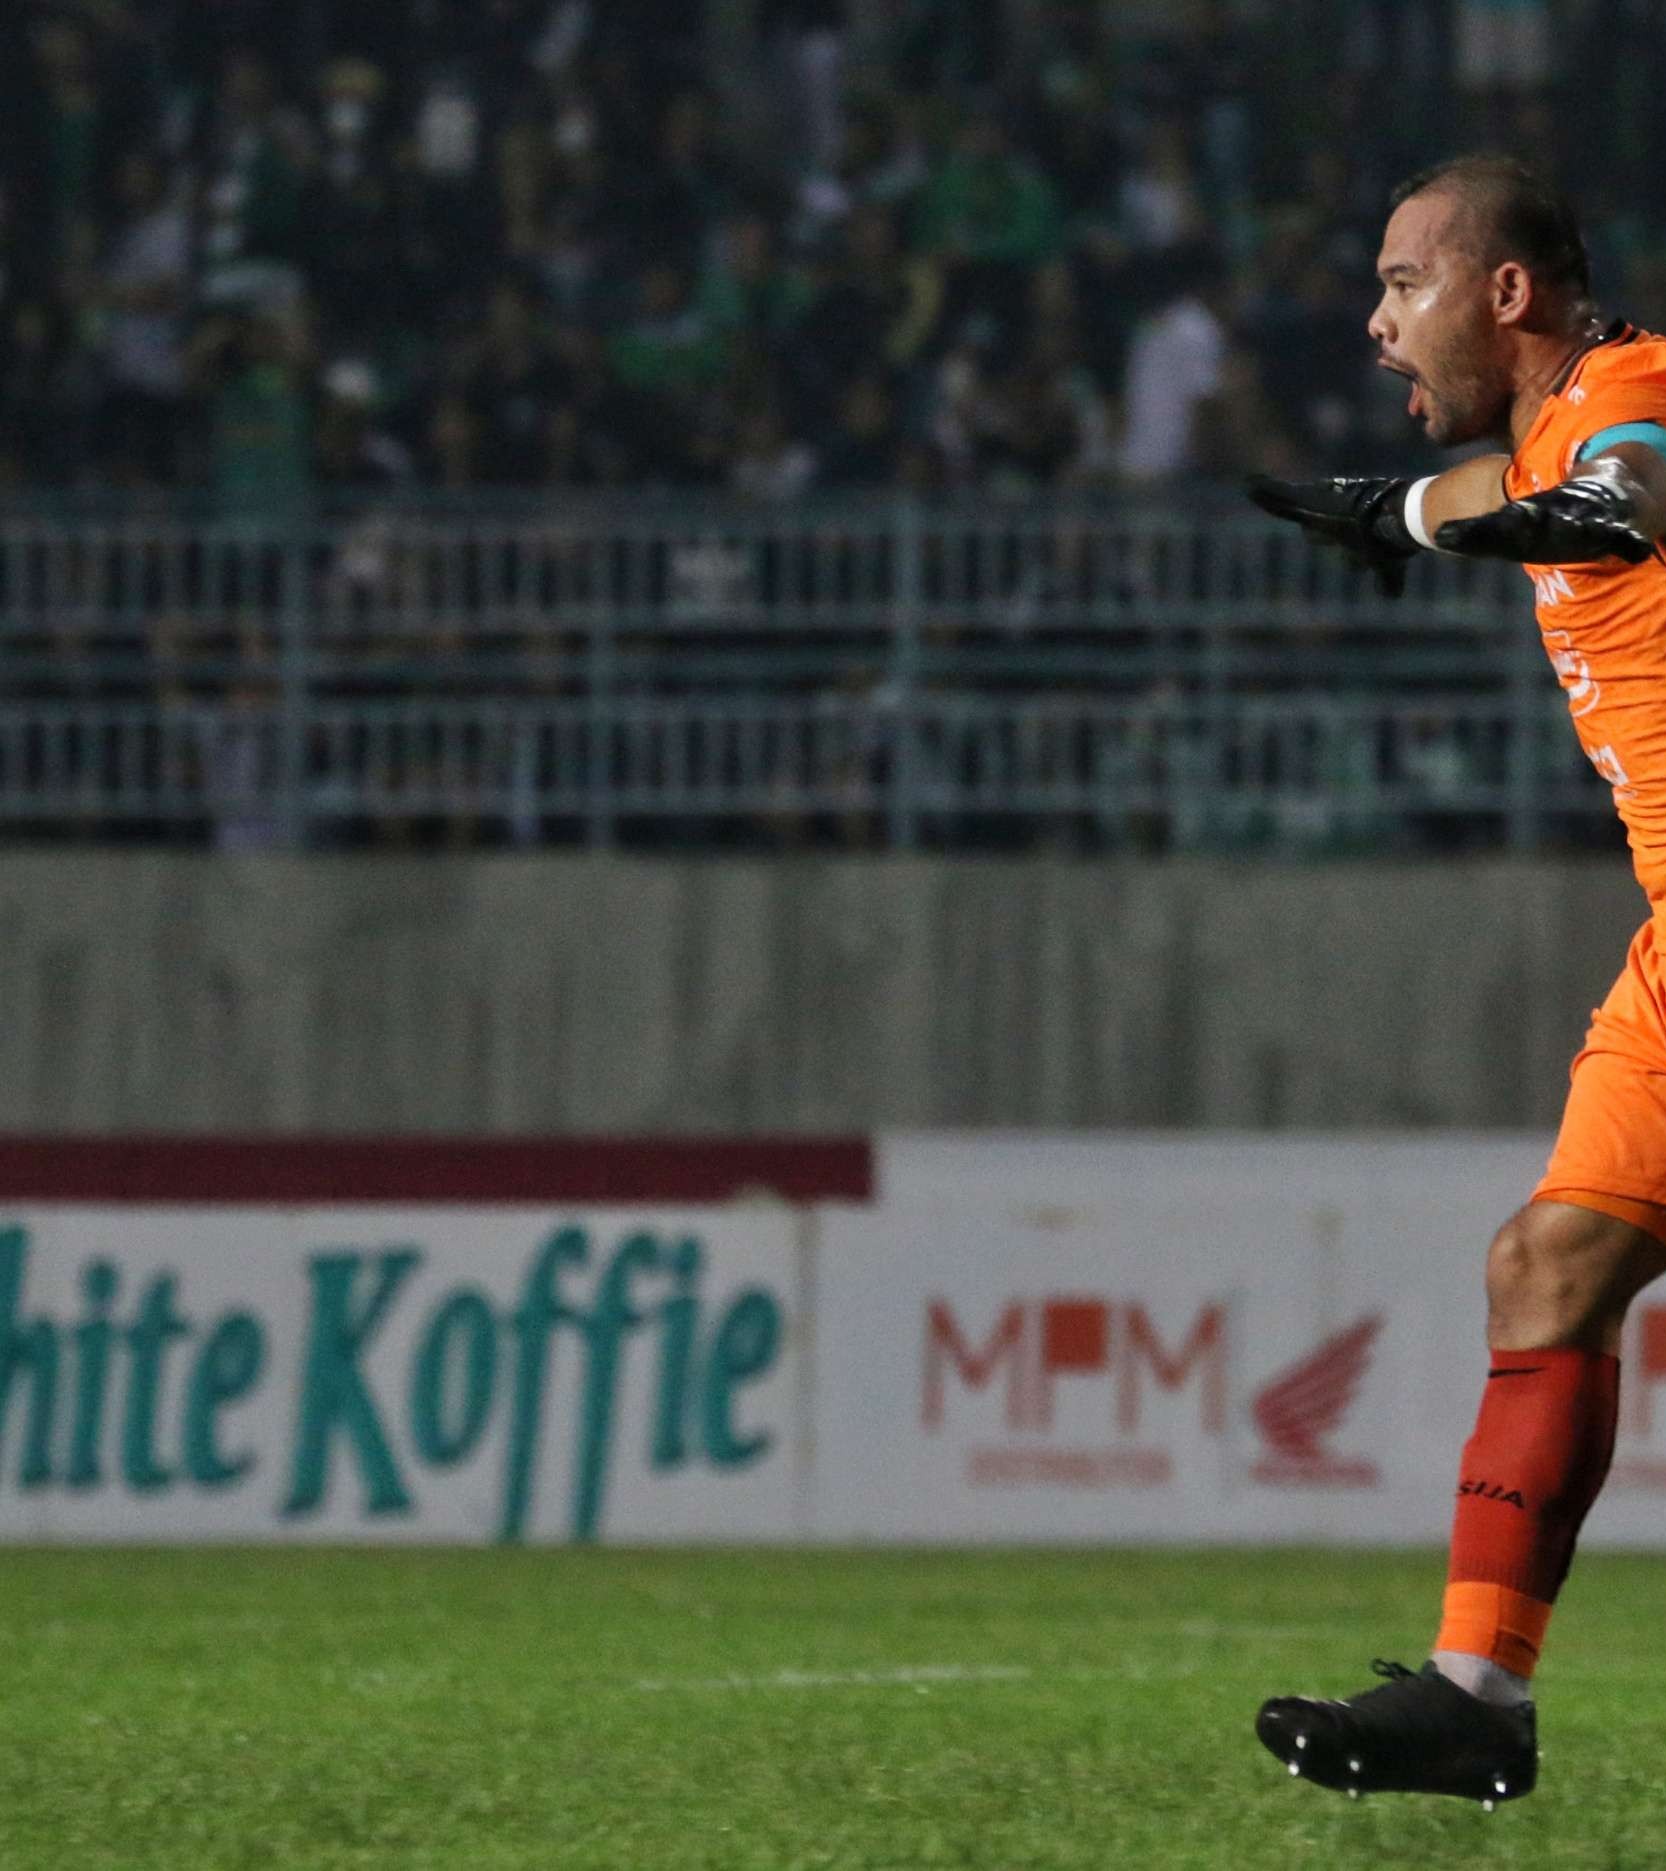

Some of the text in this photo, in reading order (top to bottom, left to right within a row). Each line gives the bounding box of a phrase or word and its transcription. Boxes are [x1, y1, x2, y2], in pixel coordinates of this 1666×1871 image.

[0, 1221, 785, 1544] hite Koffie
[921, 1295, 1230, 1435] MPM
